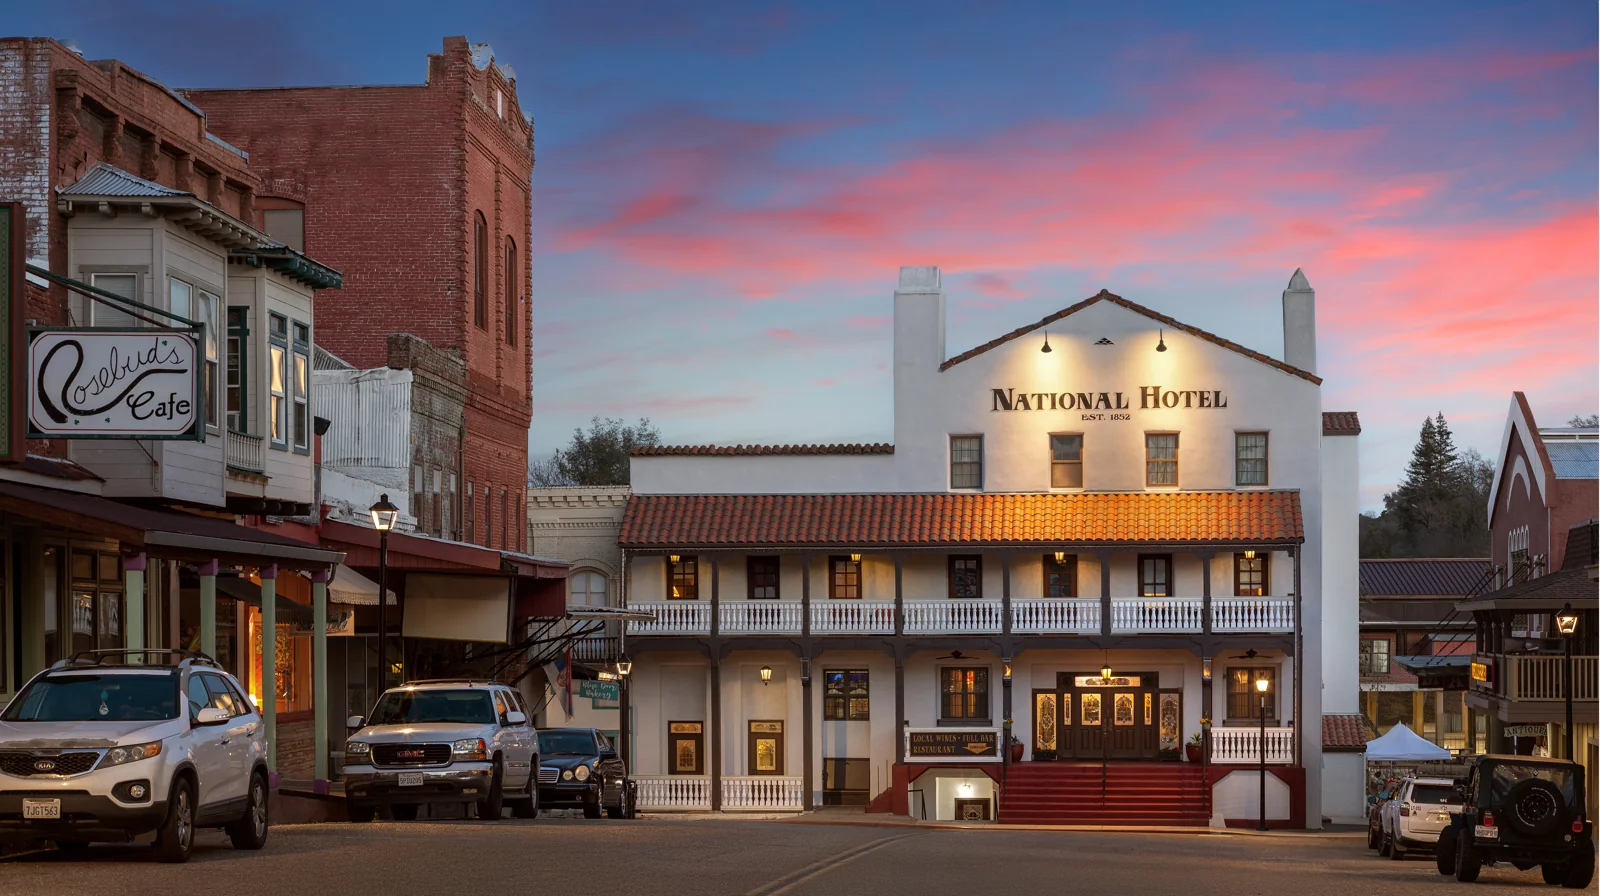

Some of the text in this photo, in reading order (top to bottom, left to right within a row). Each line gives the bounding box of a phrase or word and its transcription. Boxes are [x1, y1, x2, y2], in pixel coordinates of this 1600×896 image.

[990, 385, 1228, 412] NATIONAL HOTEL
[126, 390, 191, 421] Cafe
[1081, 413, 1131, 421] EST. 1852
[582, 681, 599, 690] Blue
[585, 690, 612, 700] Bakery
[913, 734, 994, 743] LOCAL WINES FULL BAR
[396, 749, 425, 758] GMC
[913, 745, 956, 754] RESTAURANT
[38, 761, 53, 769] KIA
[25, 805, 58, 816] 7JGT563
